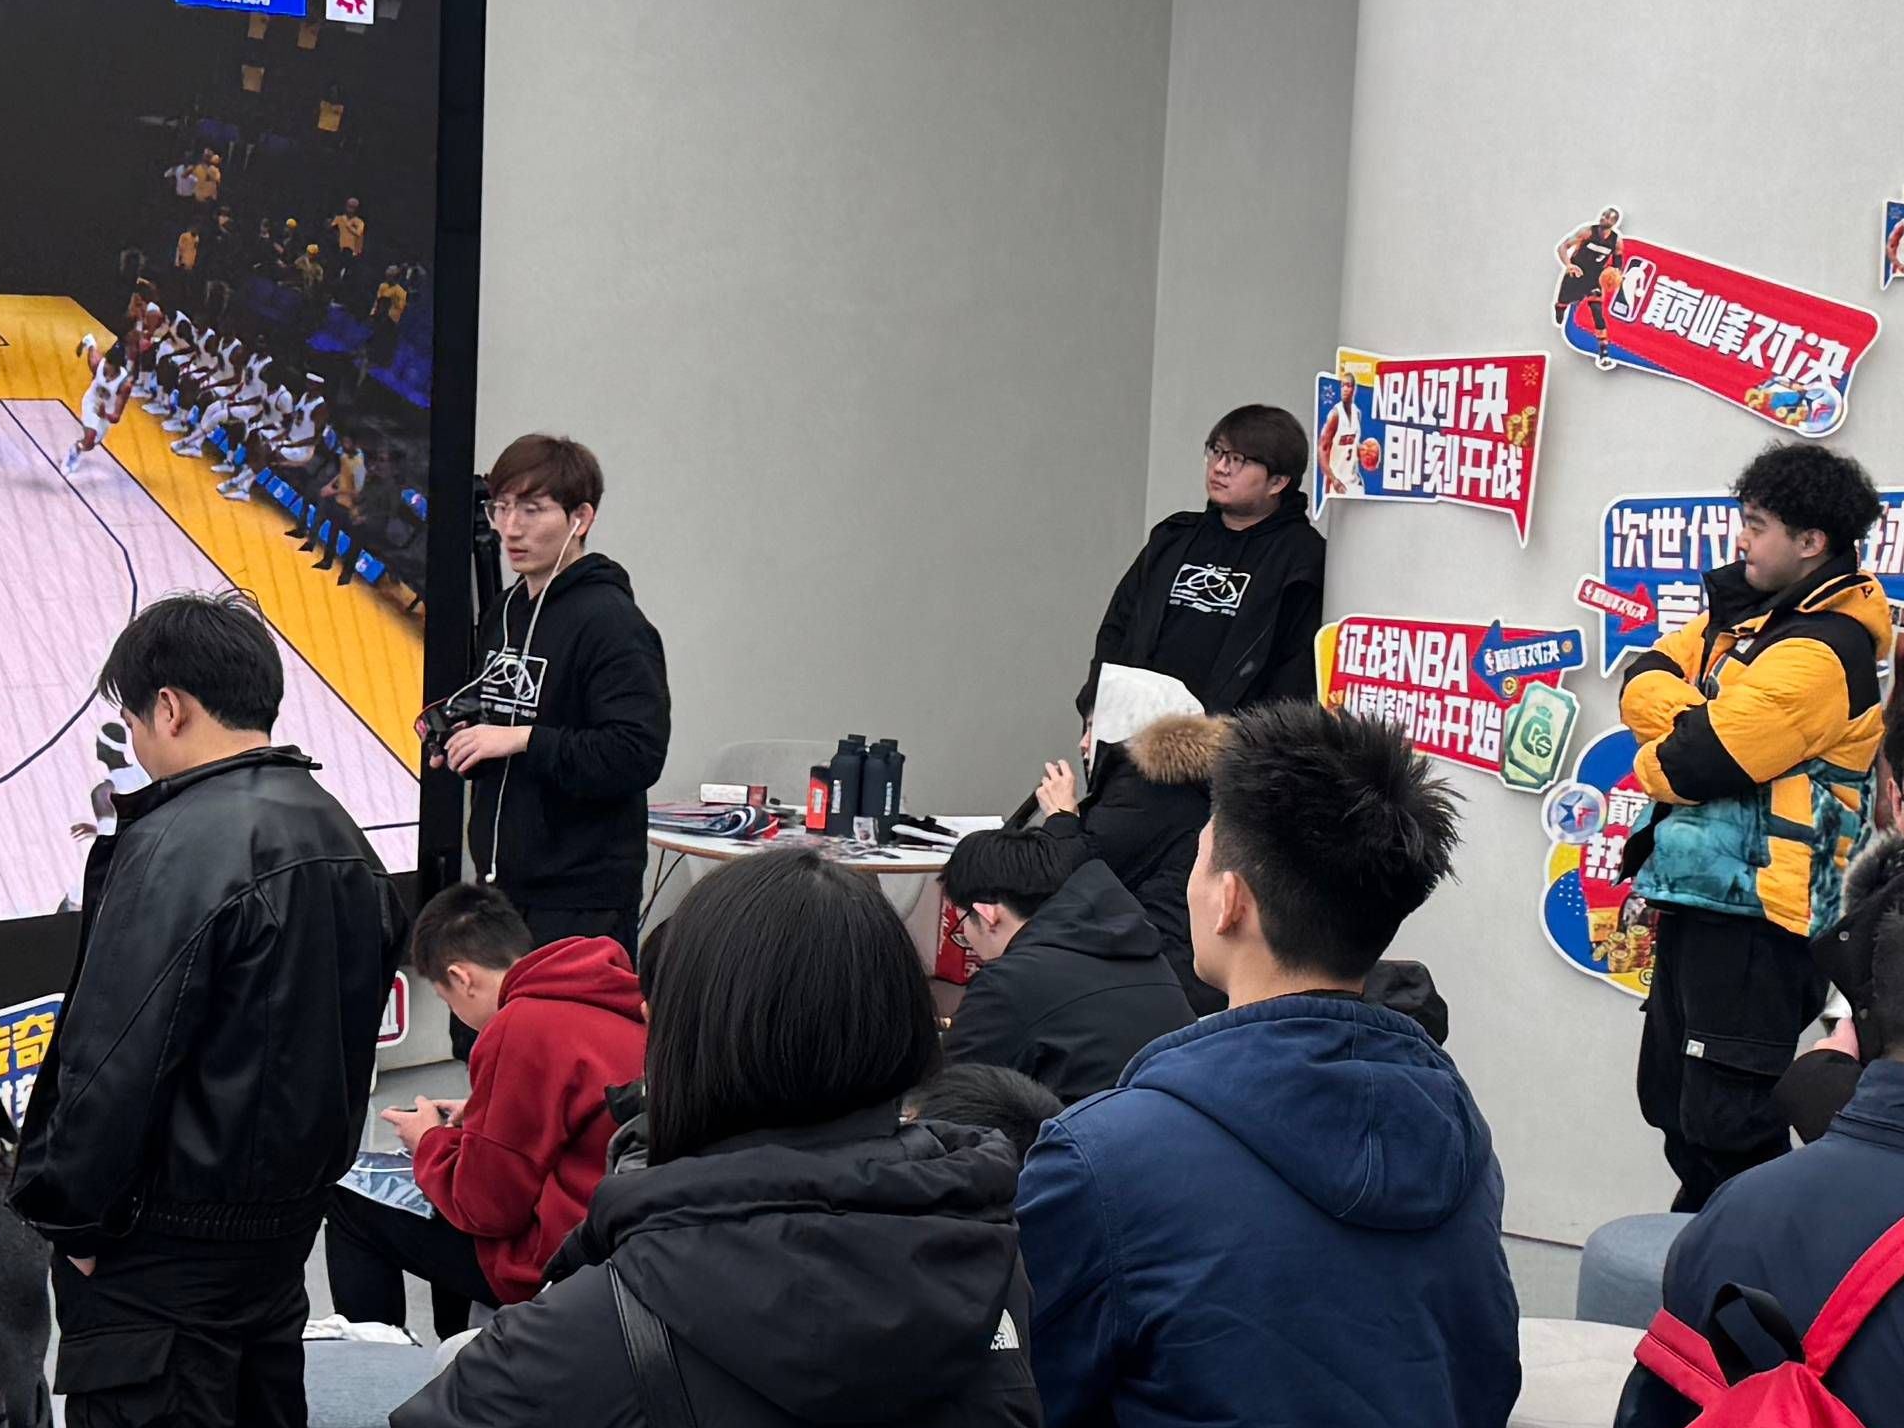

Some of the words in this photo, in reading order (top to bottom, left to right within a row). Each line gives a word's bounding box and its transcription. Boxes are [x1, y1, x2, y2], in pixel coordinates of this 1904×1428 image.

[1642, 275, 1850, 388] 巅峰对决
[1371, 364, 1509, 433] NBA对决
[1382, 424, 1523, 501] 即刻开战
[1338, 624, 1468, 693] 征战NBA
